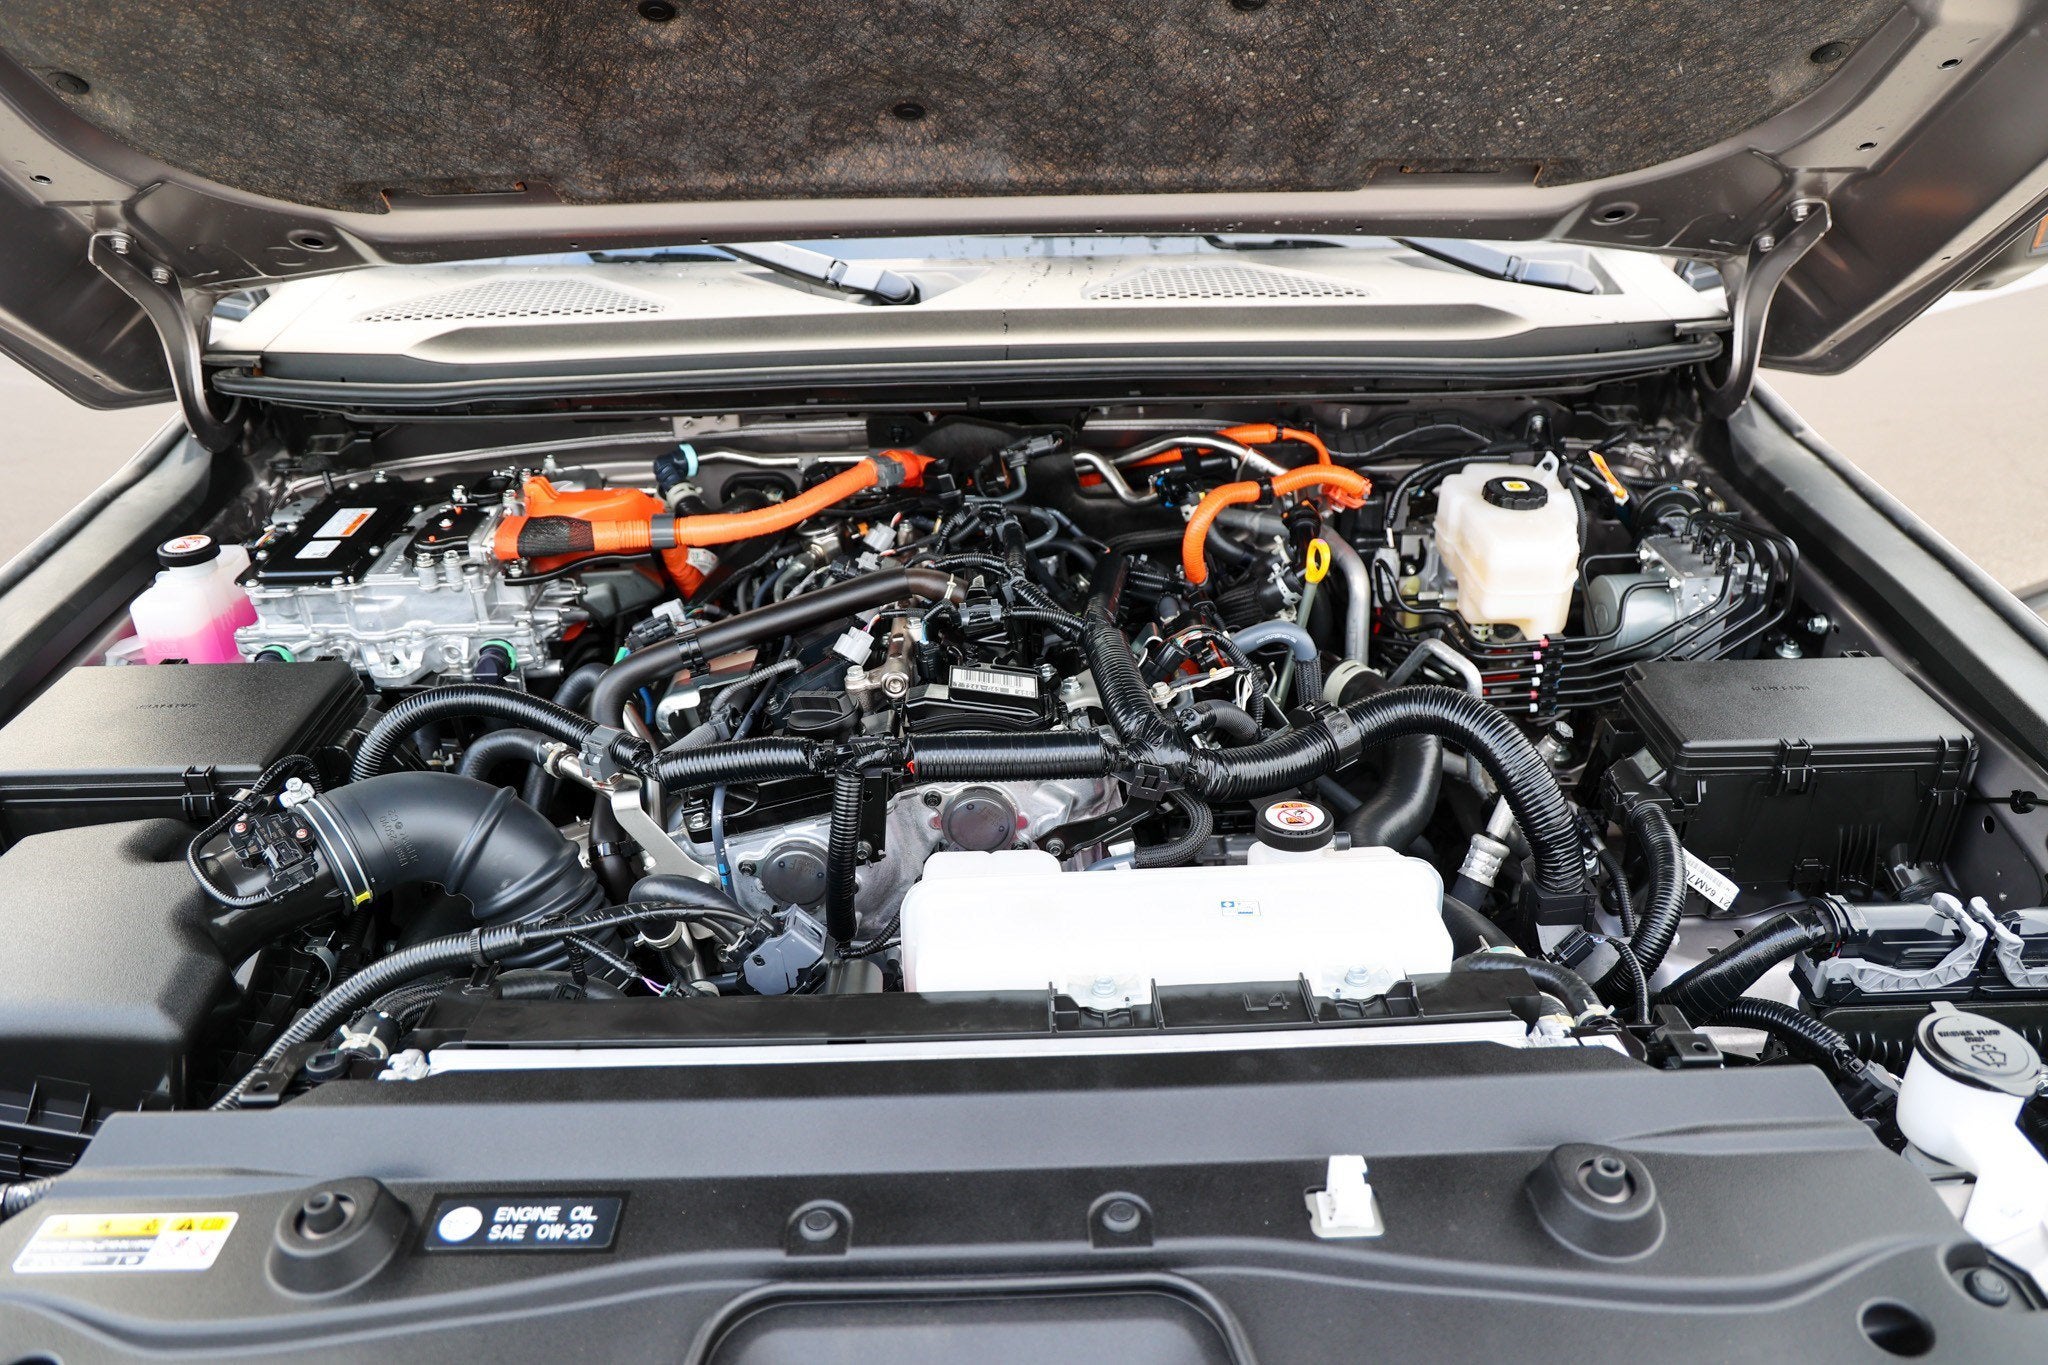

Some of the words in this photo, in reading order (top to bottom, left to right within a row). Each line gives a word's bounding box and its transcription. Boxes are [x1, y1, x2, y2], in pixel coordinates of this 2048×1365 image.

[494, 1205, 561, 1223] ENGINE
[569, 1205, 598, 1222] OIL
[488, 1223, 528, 1240] SAE
[536, 1223, 593, 1240] 0W-20
